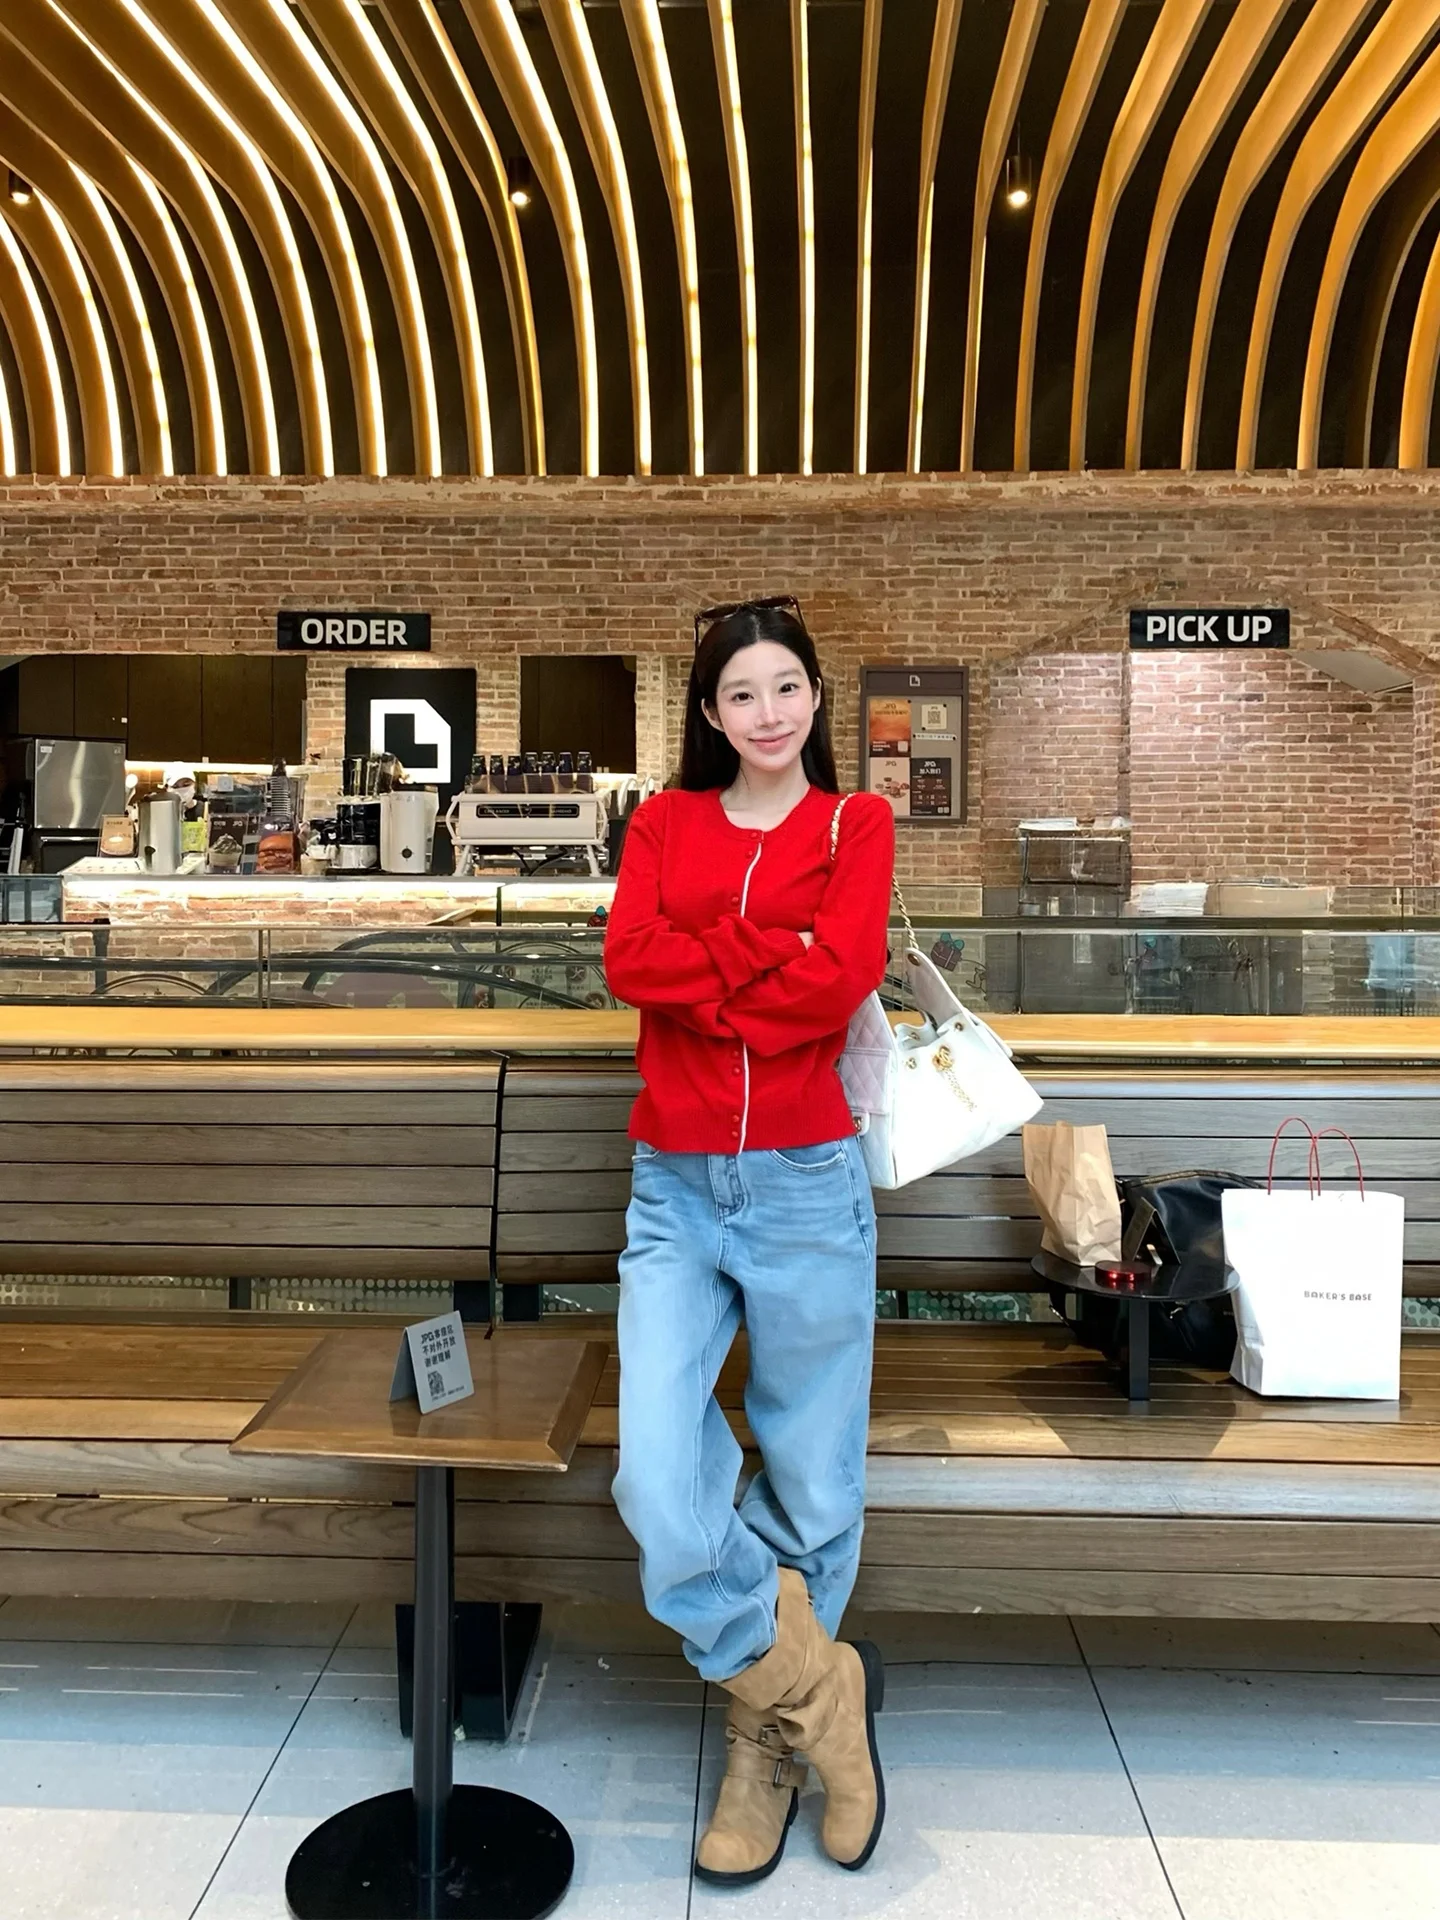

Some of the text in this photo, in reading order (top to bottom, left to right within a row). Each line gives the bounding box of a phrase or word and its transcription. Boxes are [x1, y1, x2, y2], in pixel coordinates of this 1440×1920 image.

[300, 618, 408, 646] ORDER
[1146, 614, 1272, 643] PICK UP
[1304, 1290, 1372, 1301] BAKER'S BASE
[422, 1335, 456, 1356] 不对外开放
[424, 1350, 451, 1368] 谢谢理解
